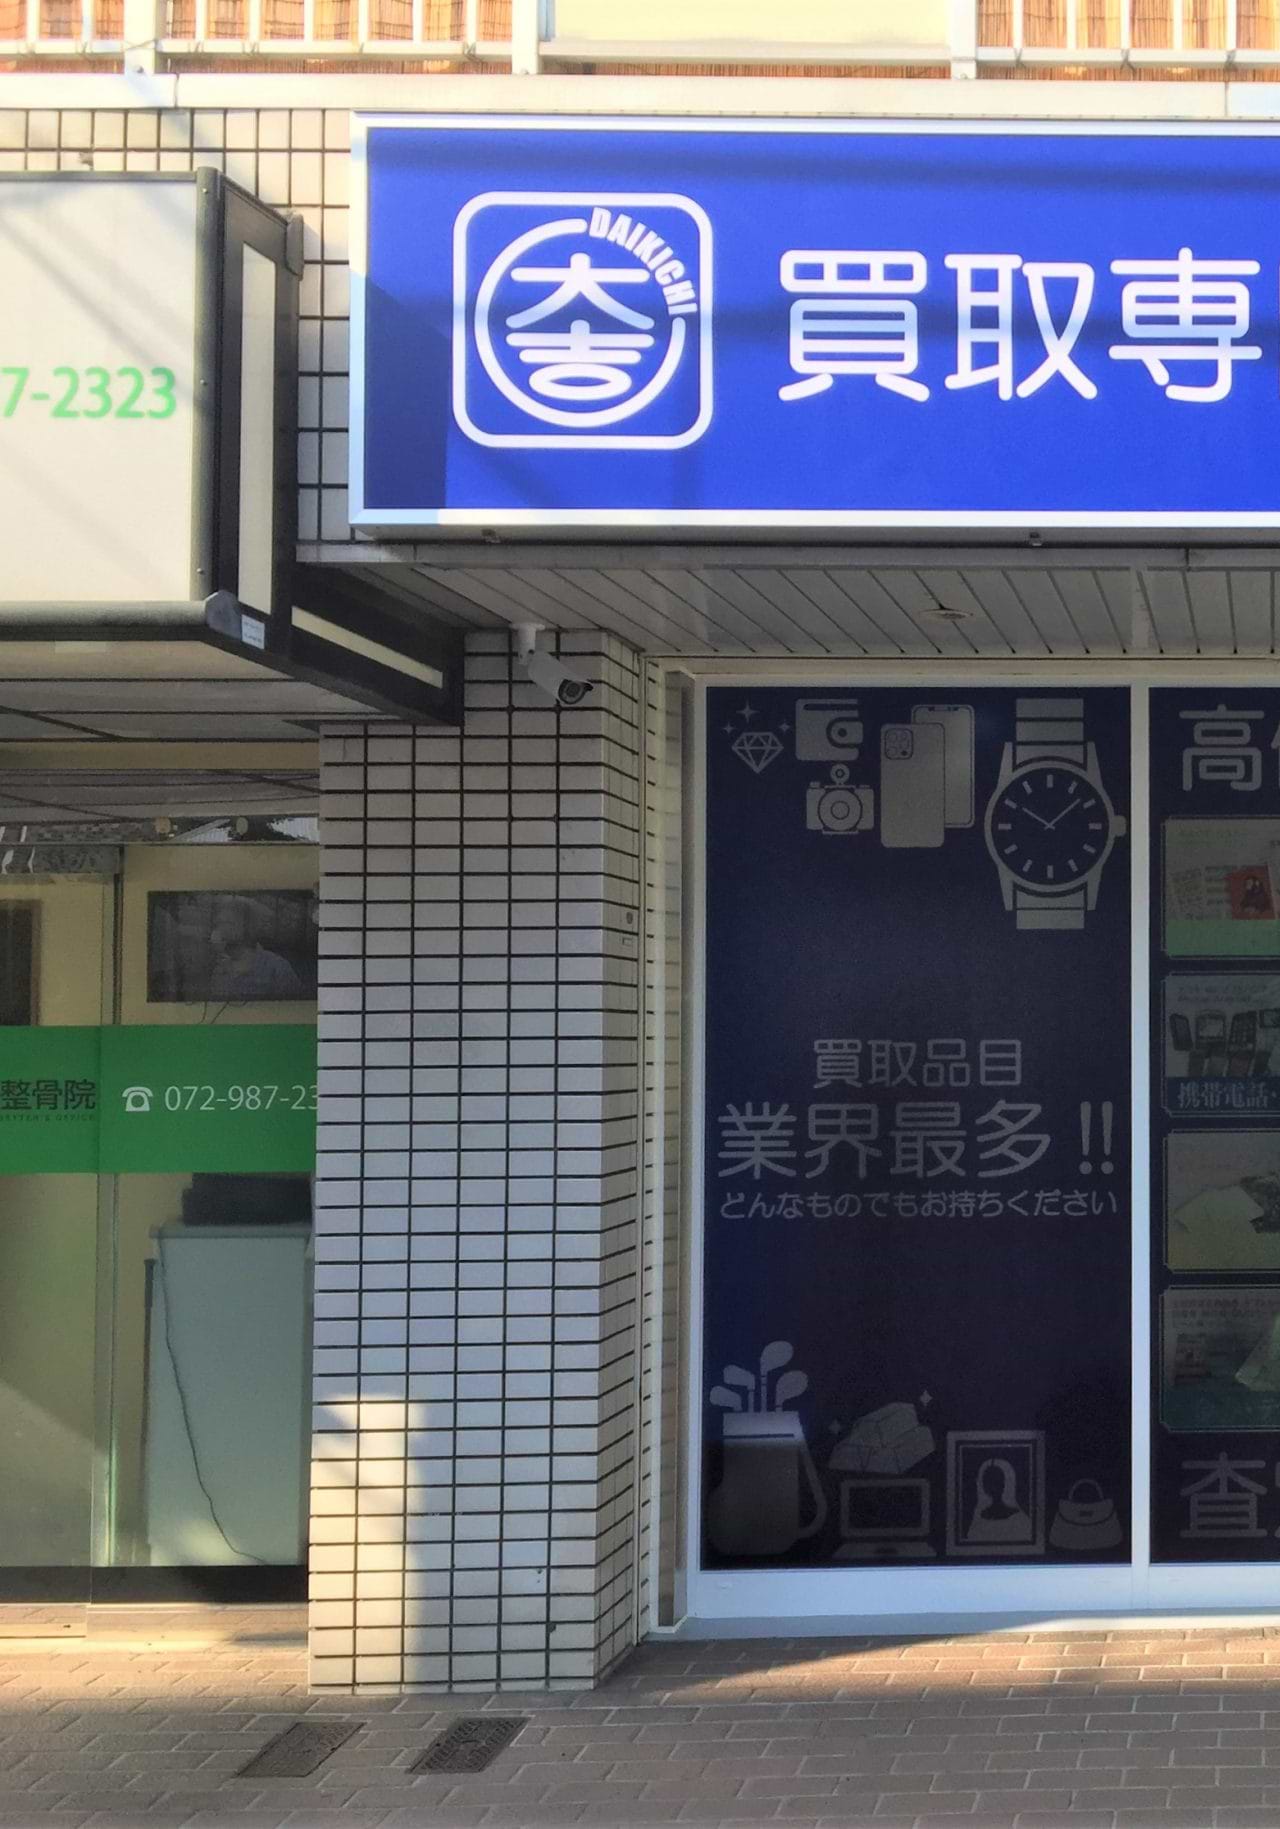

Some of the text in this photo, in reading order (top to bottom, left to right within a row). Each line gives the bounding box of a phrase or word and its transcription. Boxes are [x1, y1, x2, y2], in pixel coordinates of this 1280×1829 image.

[588, 206, 699, 316] DAIKICHI
[0, 366, 178, 420] 7-2323
[813, 1038, 1023, 1089] 買取品目
[0, 1079, 97, 1110] 整骨院
[719, 1189, 1118, 1219] どんなものでもお持ちください
